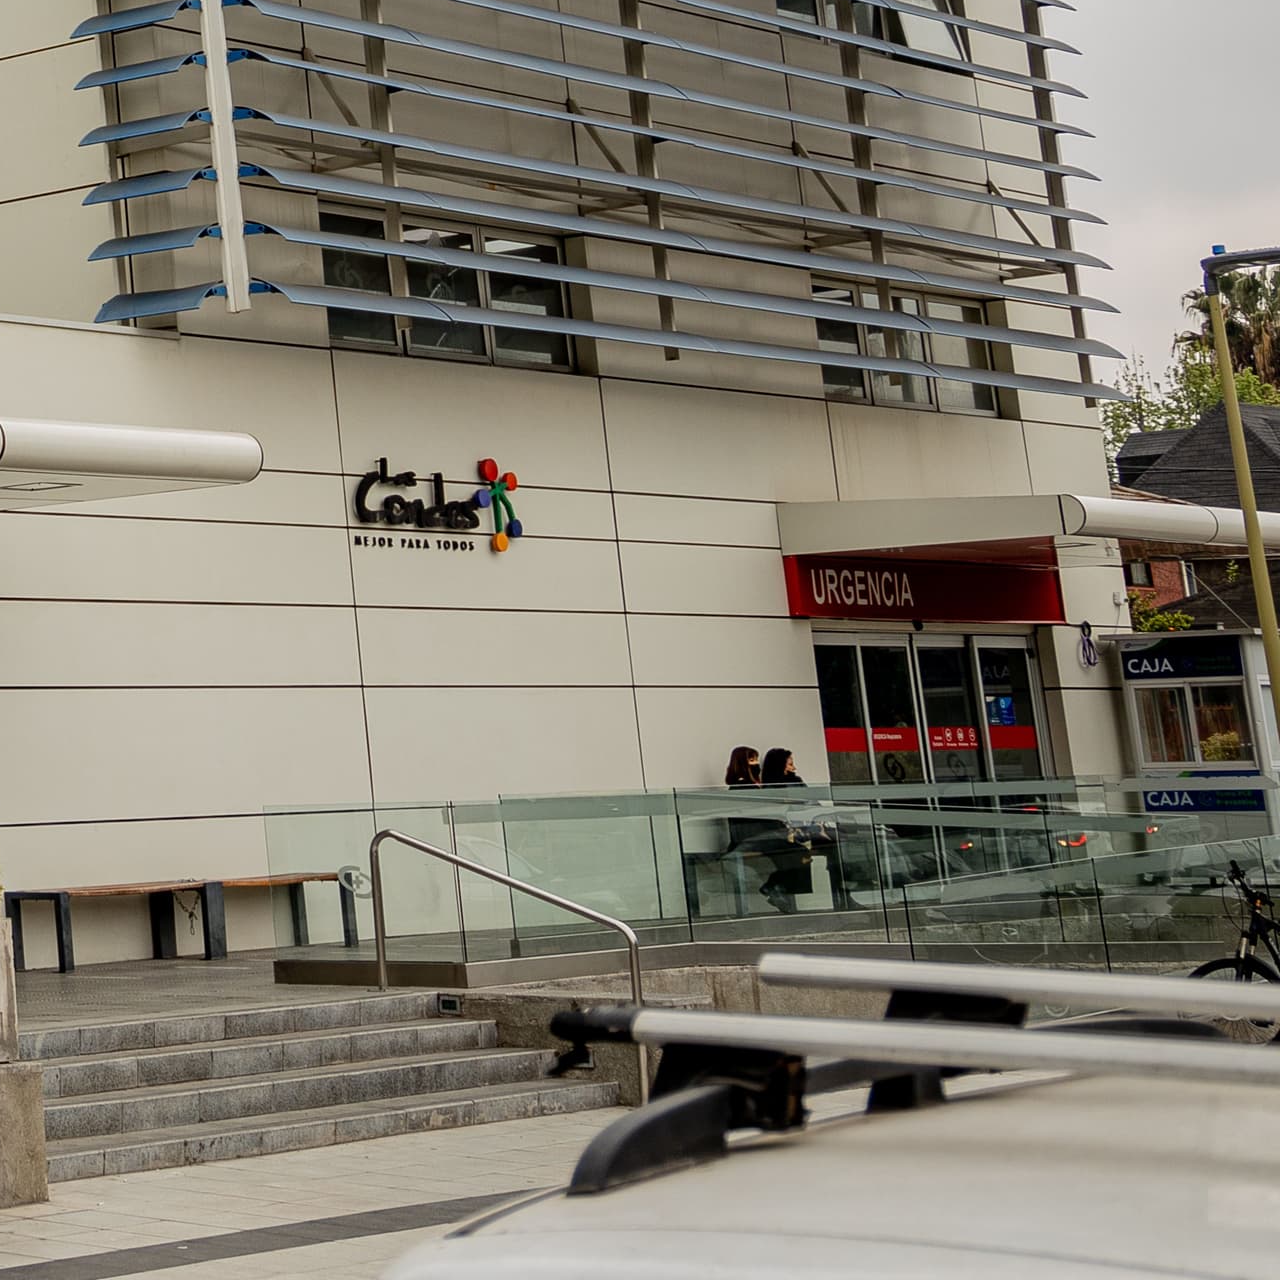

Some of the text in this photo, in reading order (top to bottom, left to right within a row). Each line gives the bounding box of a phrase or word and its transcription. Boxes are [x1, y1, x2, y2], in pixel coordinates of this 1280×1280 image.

[354, 535, 475, 551] MEJOR PARA TODOS
[810, 568, 914, 607] URGENCIA
[1127, 658, 1174, 674] CAJA
[1146, 791, 1194, 806] CAJA
